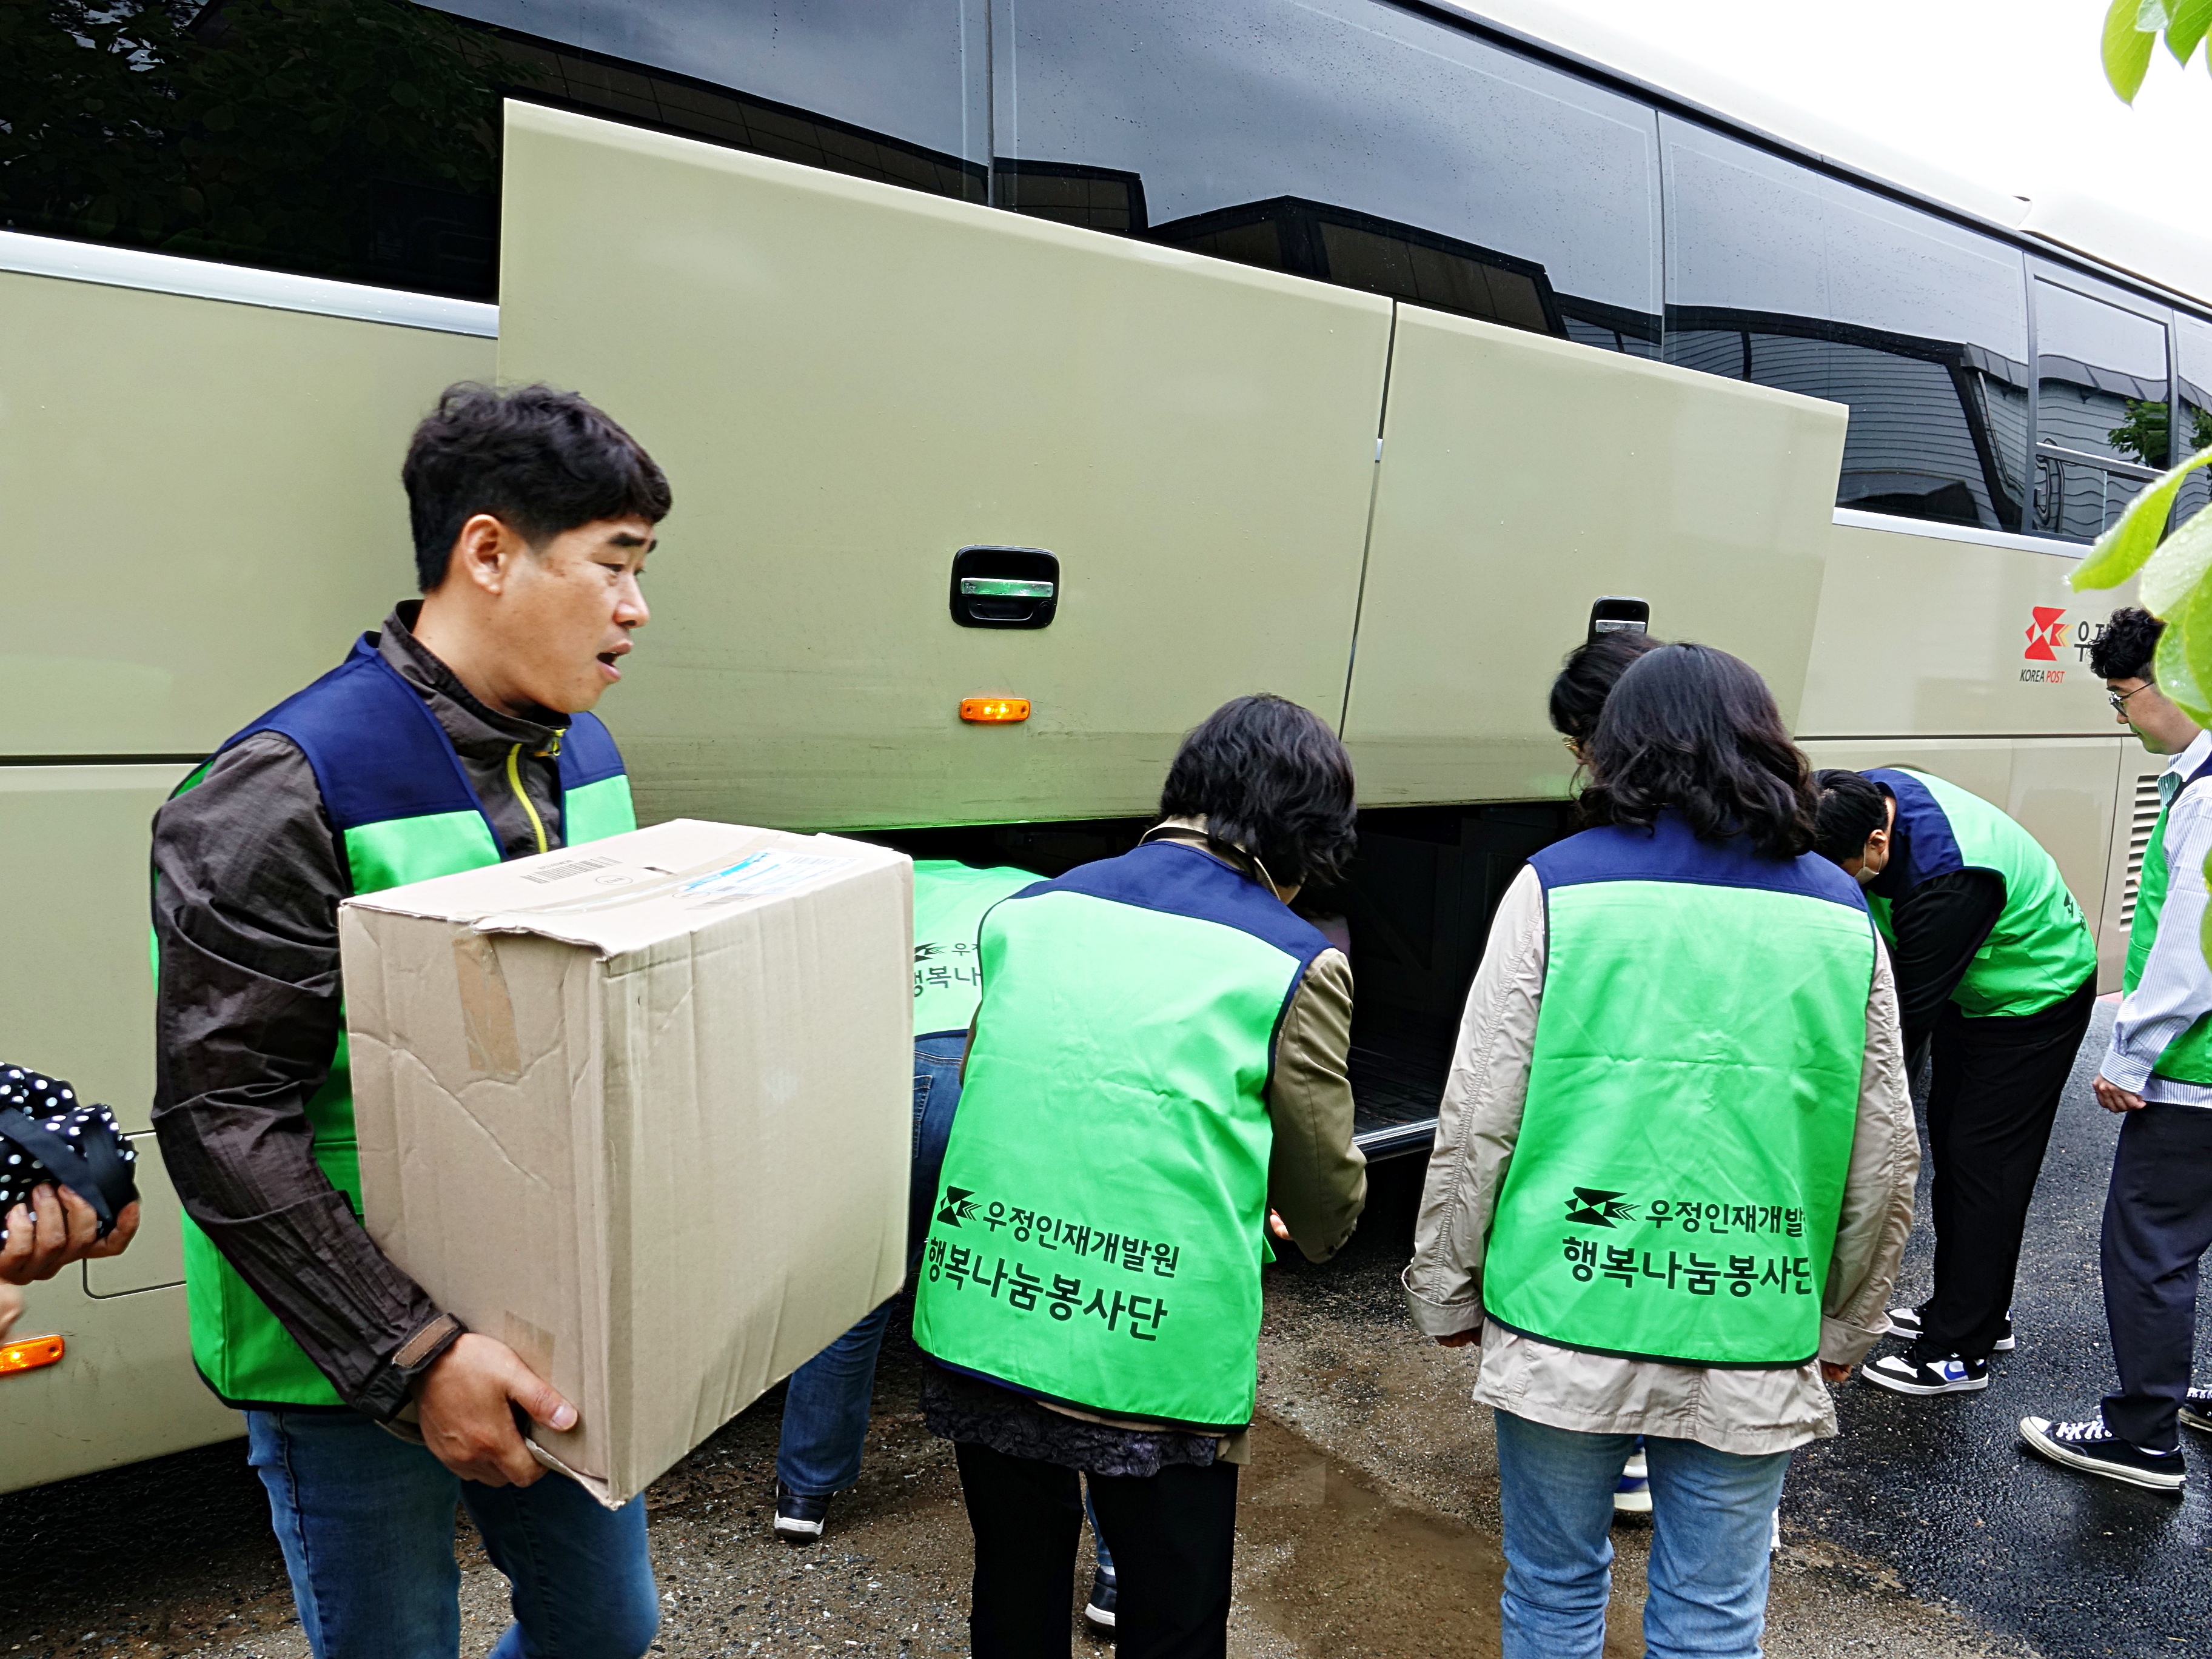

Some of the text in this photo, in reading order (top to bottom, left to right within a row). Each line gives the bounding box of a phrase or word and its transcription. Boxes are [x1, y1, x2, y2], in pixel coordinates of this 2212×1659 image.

[2019, 669, 2065, 683] KOREA POST
[951, 943, 977, 956] 우
[1645, 1199, 1807, 1238] 우정인재개발
[982, 1201, 1180, 1279] 우정인재개발원
[928, 1236, 1168, 1342] 행복나눔봉사단
